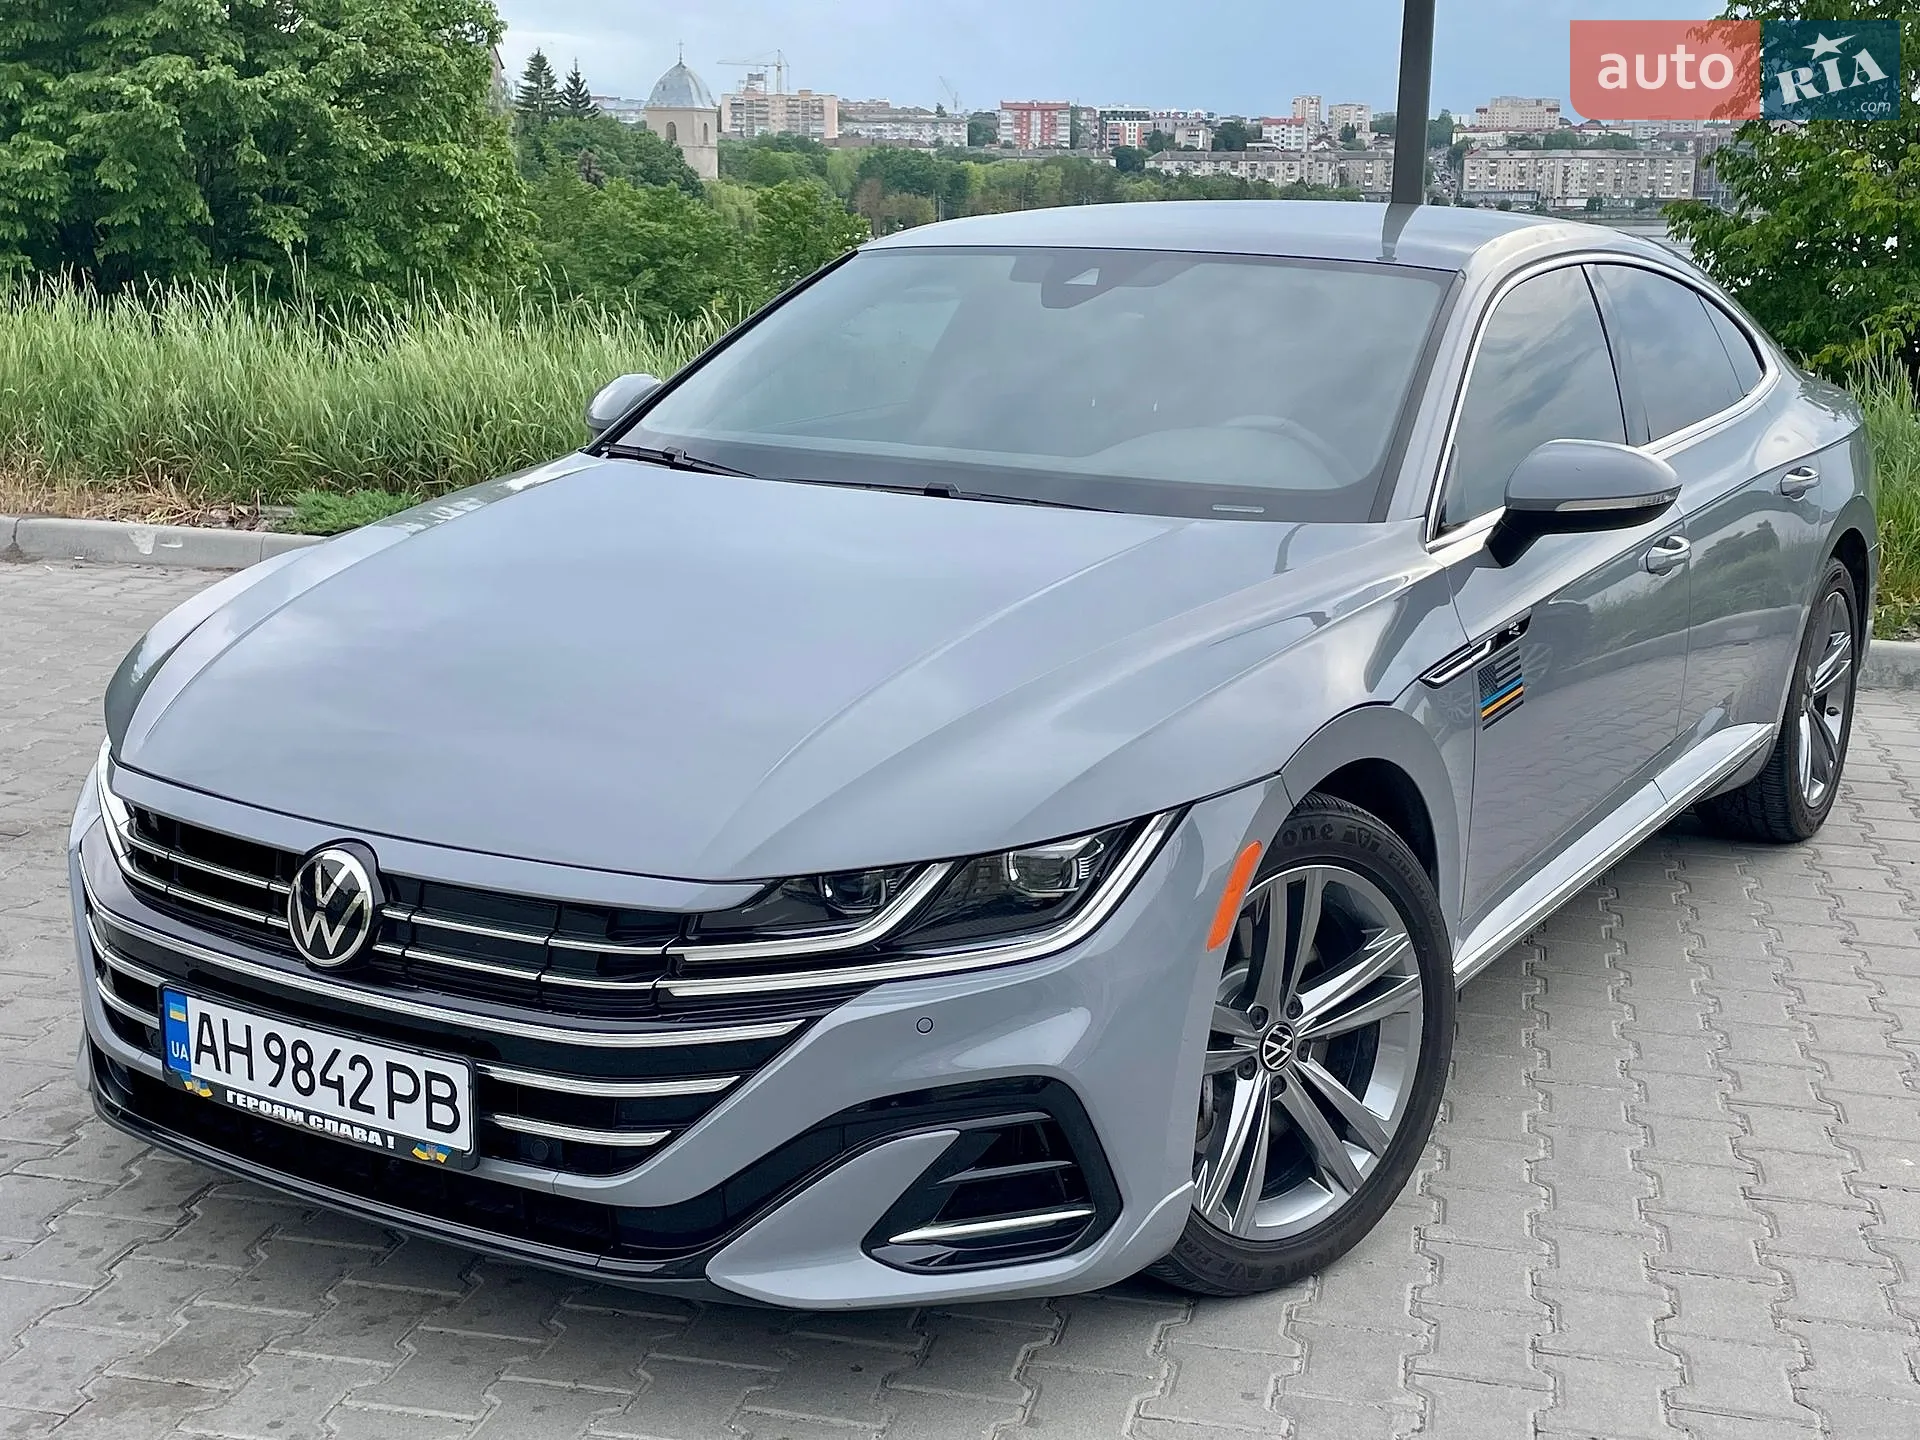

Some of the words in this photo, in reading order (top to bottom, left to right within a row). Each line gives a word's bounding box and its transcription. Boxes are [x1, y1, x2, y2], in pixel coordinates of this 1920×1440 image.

[171, 1040, 189, 1061] UA
[263, 1032, 375, 1116] 9842
[225, 1089, 304, 1125] ГЕРОЯМ
[308, 1115, 383, 1147] СЛАВА
